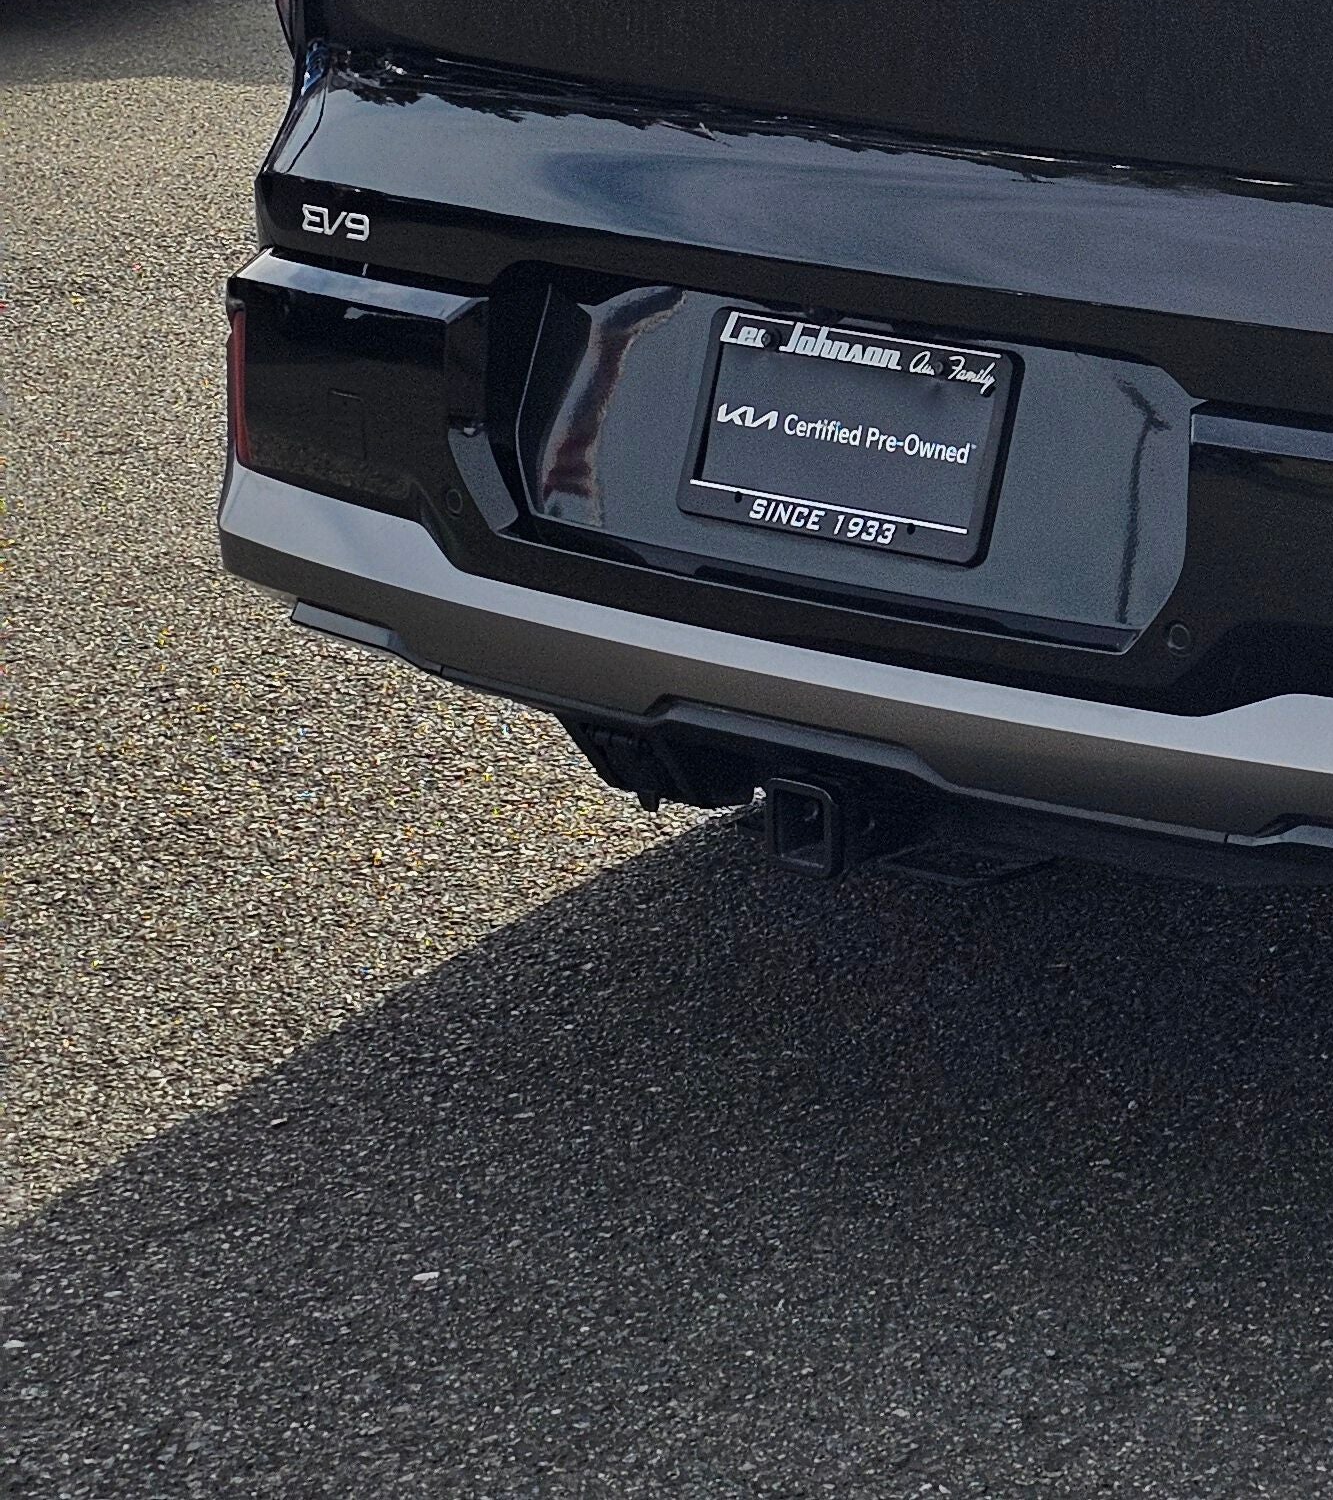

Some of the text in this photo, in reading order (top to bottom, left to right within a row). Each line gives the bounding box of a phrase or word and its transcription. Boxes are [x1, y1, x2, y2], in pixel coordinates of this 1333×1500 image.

[302, 203, 370, 241] EV9
[778, 321, 902, 371] Johnson
[909, 350, 936, 376] Au
[947, 355, 996, 395] Family
[716, 402, 971, 465] KIA Certified Pre-Owned
[749, 498, 897, 545] SINCE 1933
